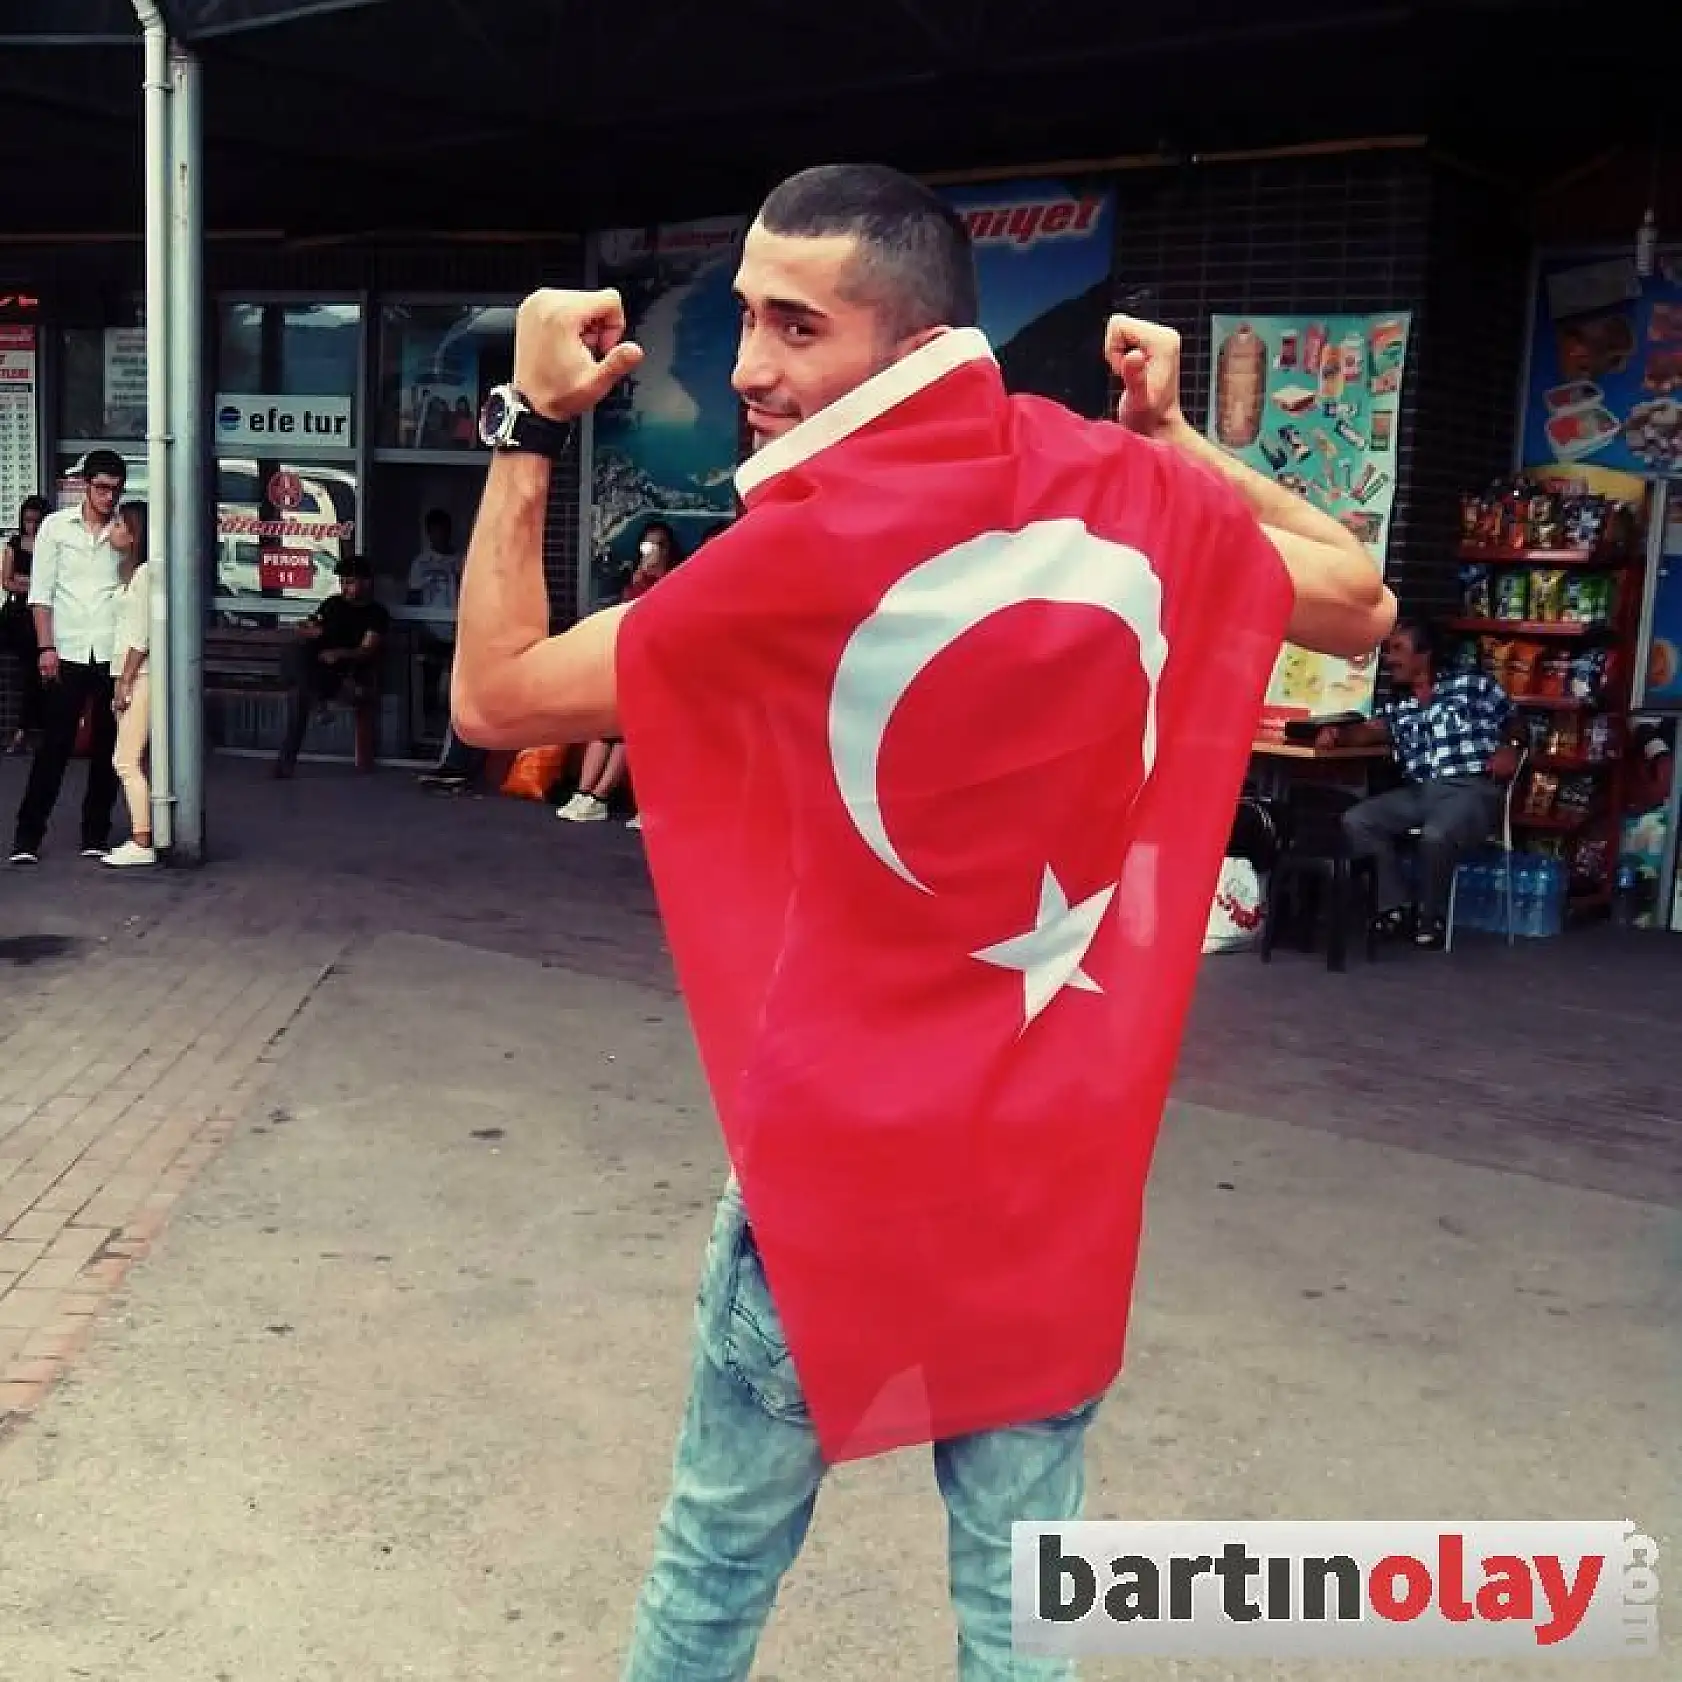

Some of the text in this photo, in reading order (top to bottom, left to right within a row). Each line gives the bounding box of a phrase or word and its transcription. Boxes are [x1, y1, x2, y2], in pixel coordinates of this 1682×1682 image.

[249, 407, 348, 435] efe tur
[262, 553, 310, 567] PERON
